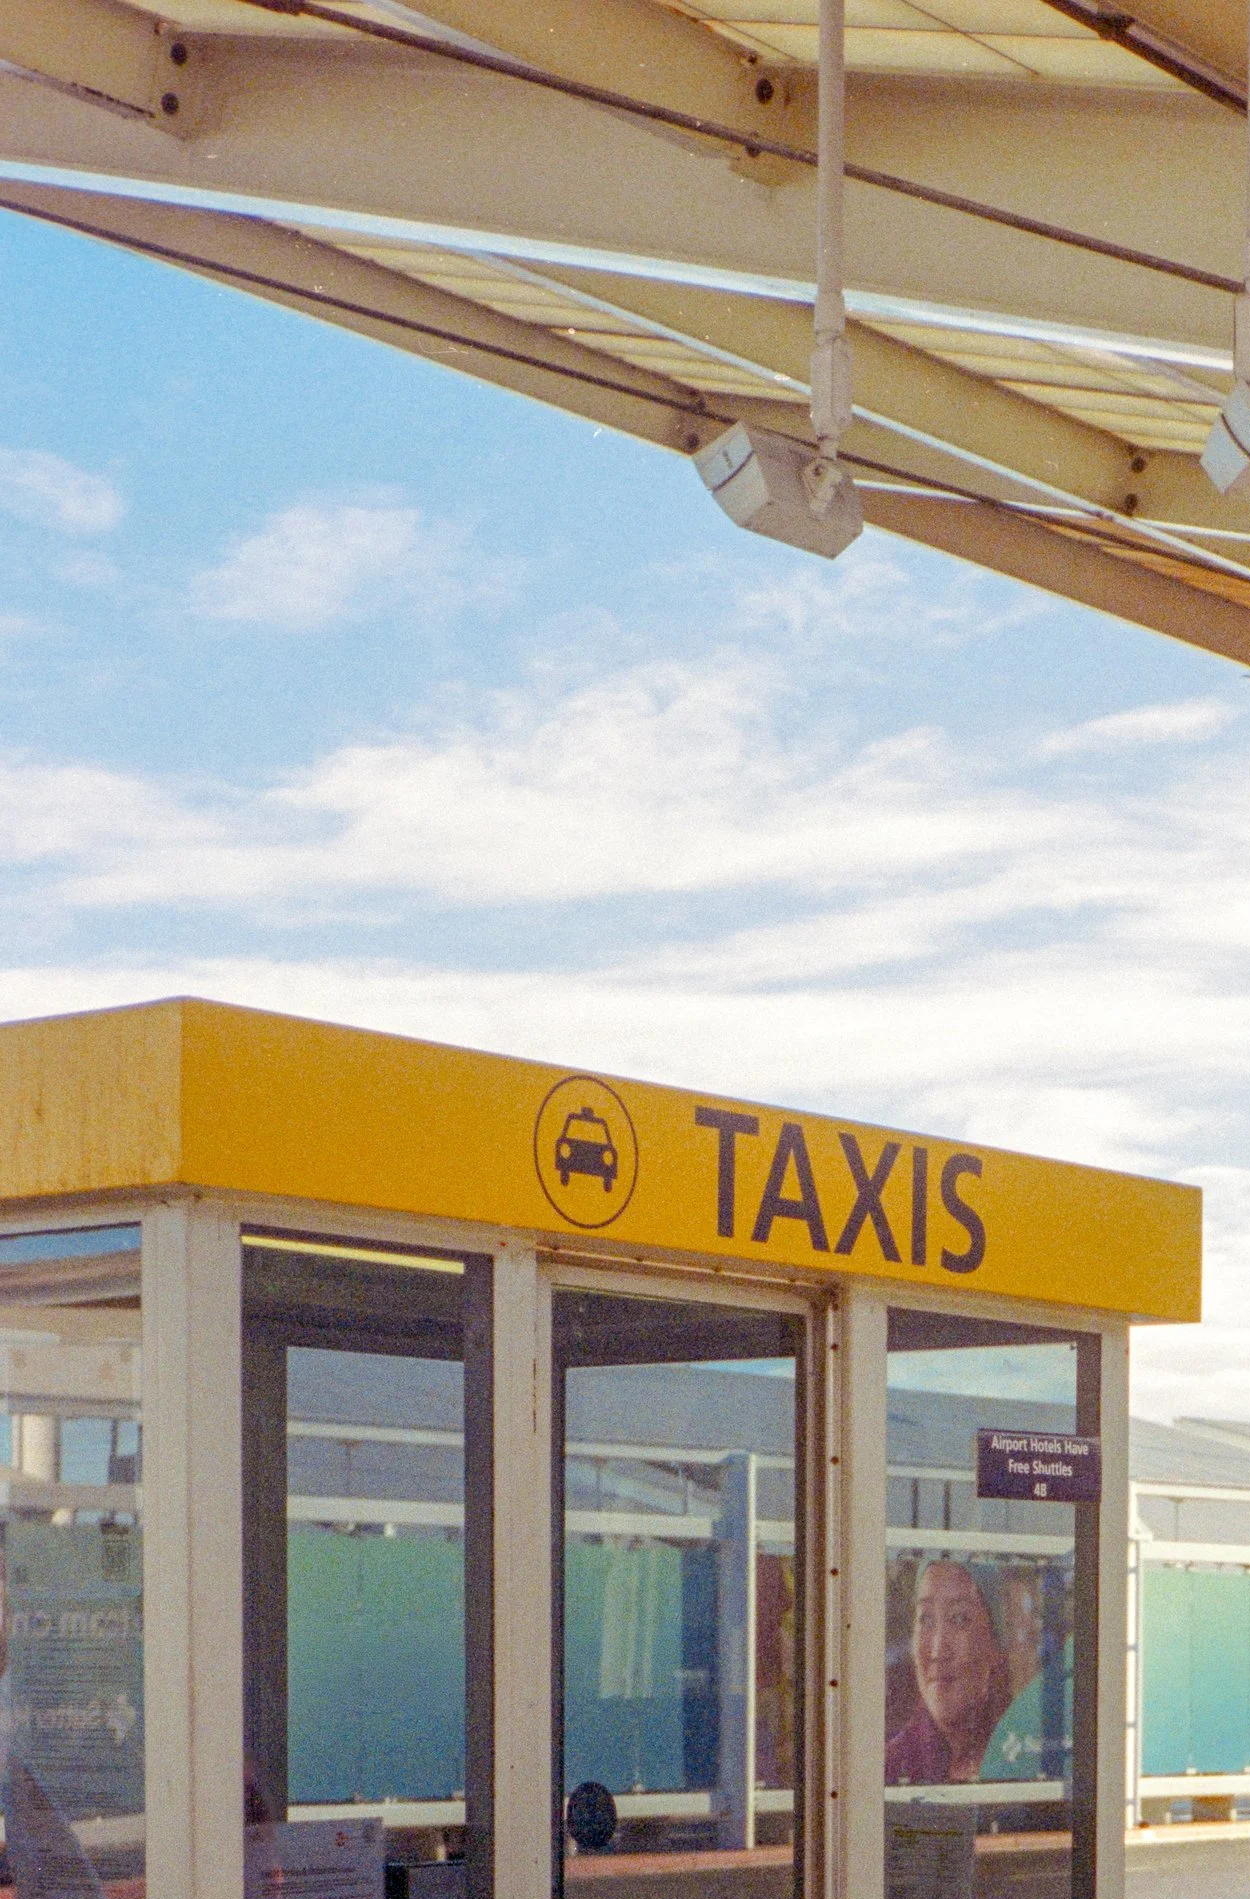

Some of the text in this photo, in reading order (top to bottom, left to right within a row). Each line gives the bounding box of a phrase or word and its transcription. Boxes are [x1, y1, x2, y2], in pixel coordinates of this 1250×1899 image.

[694, 1106, 986, 1274] TAXIS
[991, 1435, 1089, 1456] Airport Hotels Have
[1008, 1458, 1073, 1477] Free Shuttles
[1034, 1483, 1047, 1498] 4B
